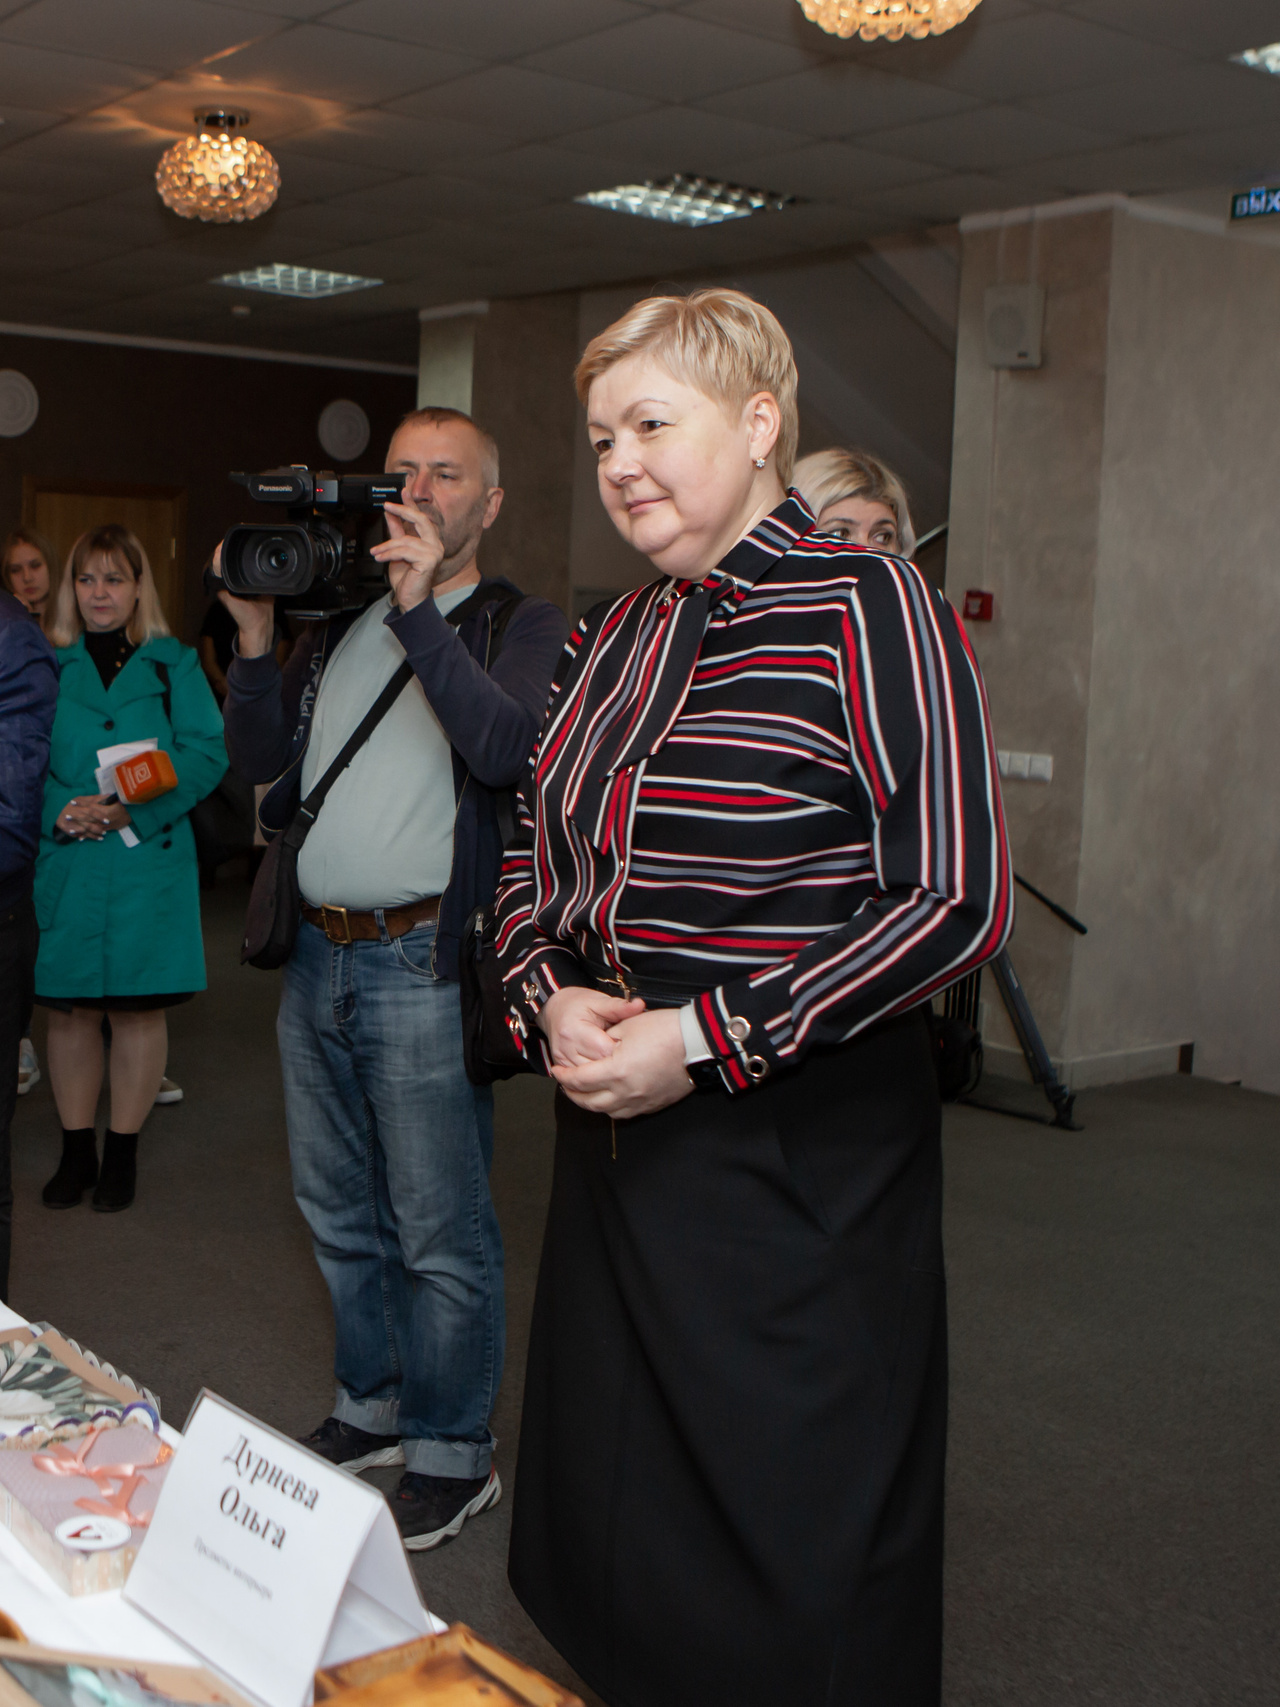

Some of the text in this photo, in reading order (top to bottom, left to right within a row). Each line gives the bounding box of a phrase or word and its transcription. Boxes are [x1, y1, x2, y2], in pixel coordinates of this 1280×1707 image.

[258, 484, 293, 492] Panasonic
[222, 1434, 320, 1511] Дурнева
[219, 1485, 287, 1550] Ольга
